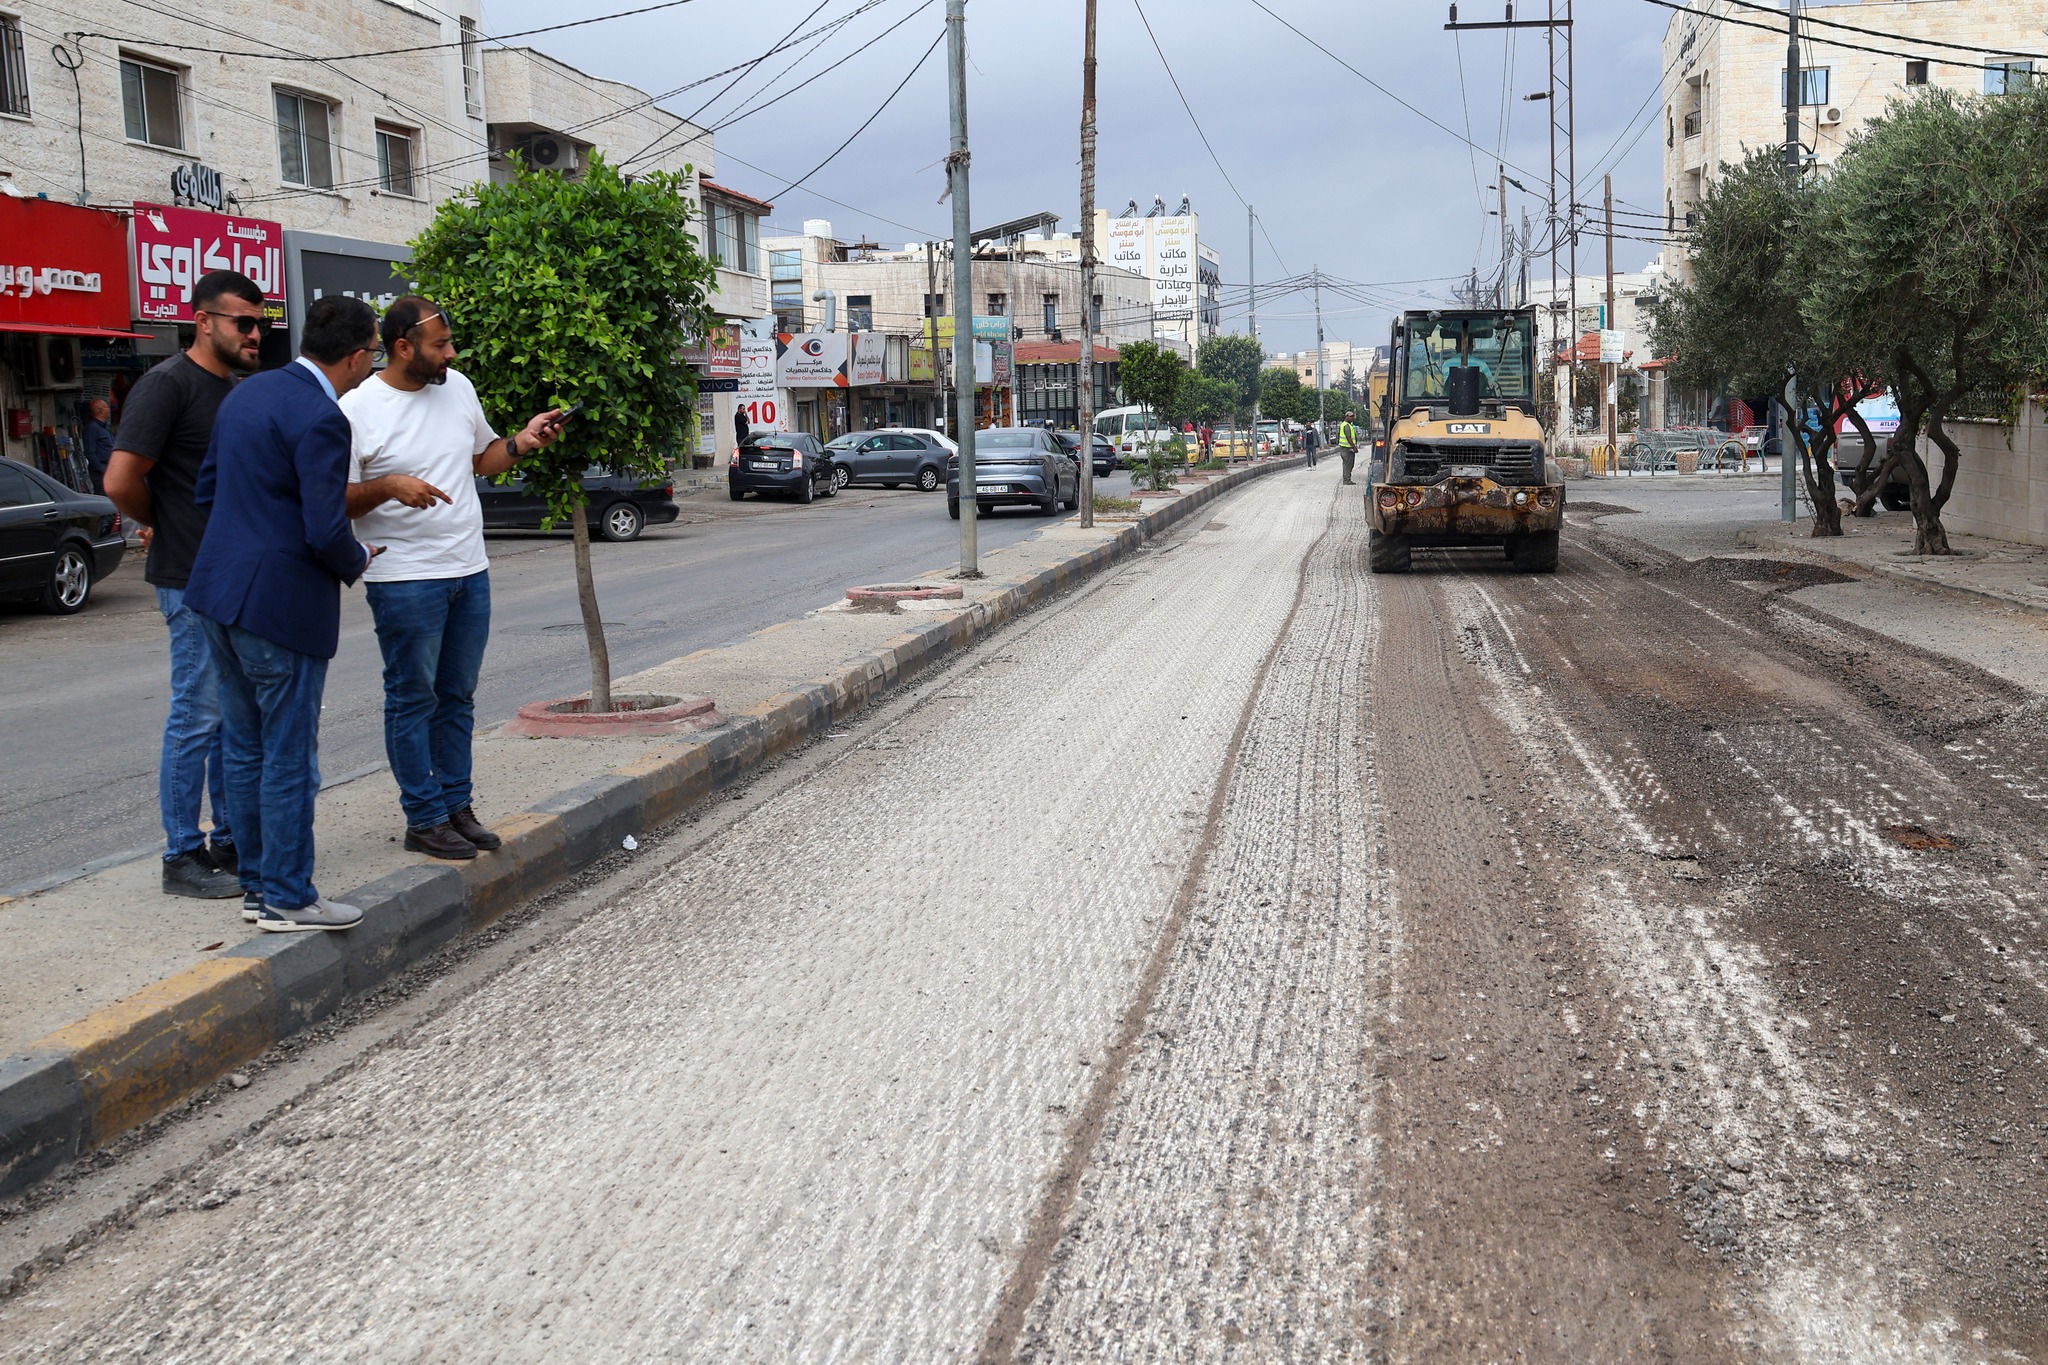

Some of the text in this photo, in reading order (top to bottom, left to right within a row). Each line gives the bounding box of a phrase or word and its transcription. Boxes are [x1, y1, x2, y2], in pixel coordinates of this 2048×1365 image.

[226, 220, 267, 245] مؤسسة
[1109, 229, 1134, 238] موسى
[1155, 227, 1179, 237] موسى
[1119, 240, 1135, 249] سنتر
[1164, 238, 1181, 247] سنتر
[1114, 250, 1141, 262] مكاتب
[1160, 248, 1187, 260] مكاتب
[141, 237, 280, 303] الملكاوي
[1159, 264, 1188, 277] تجارية
[1156, 280, 1192, 292] وعيادات
[143, 301, 178, 318] التجارية
[796, 358, 823, 366] مركز
[785, 366, 833, 375] جلاكسي للبصريات
[701, 380, 734, 390] vivo
[1032, 378, 1068, 392] عصائر
[747, 401, 776, 424] 10
[1450, 424, 1486, 433] CAT
